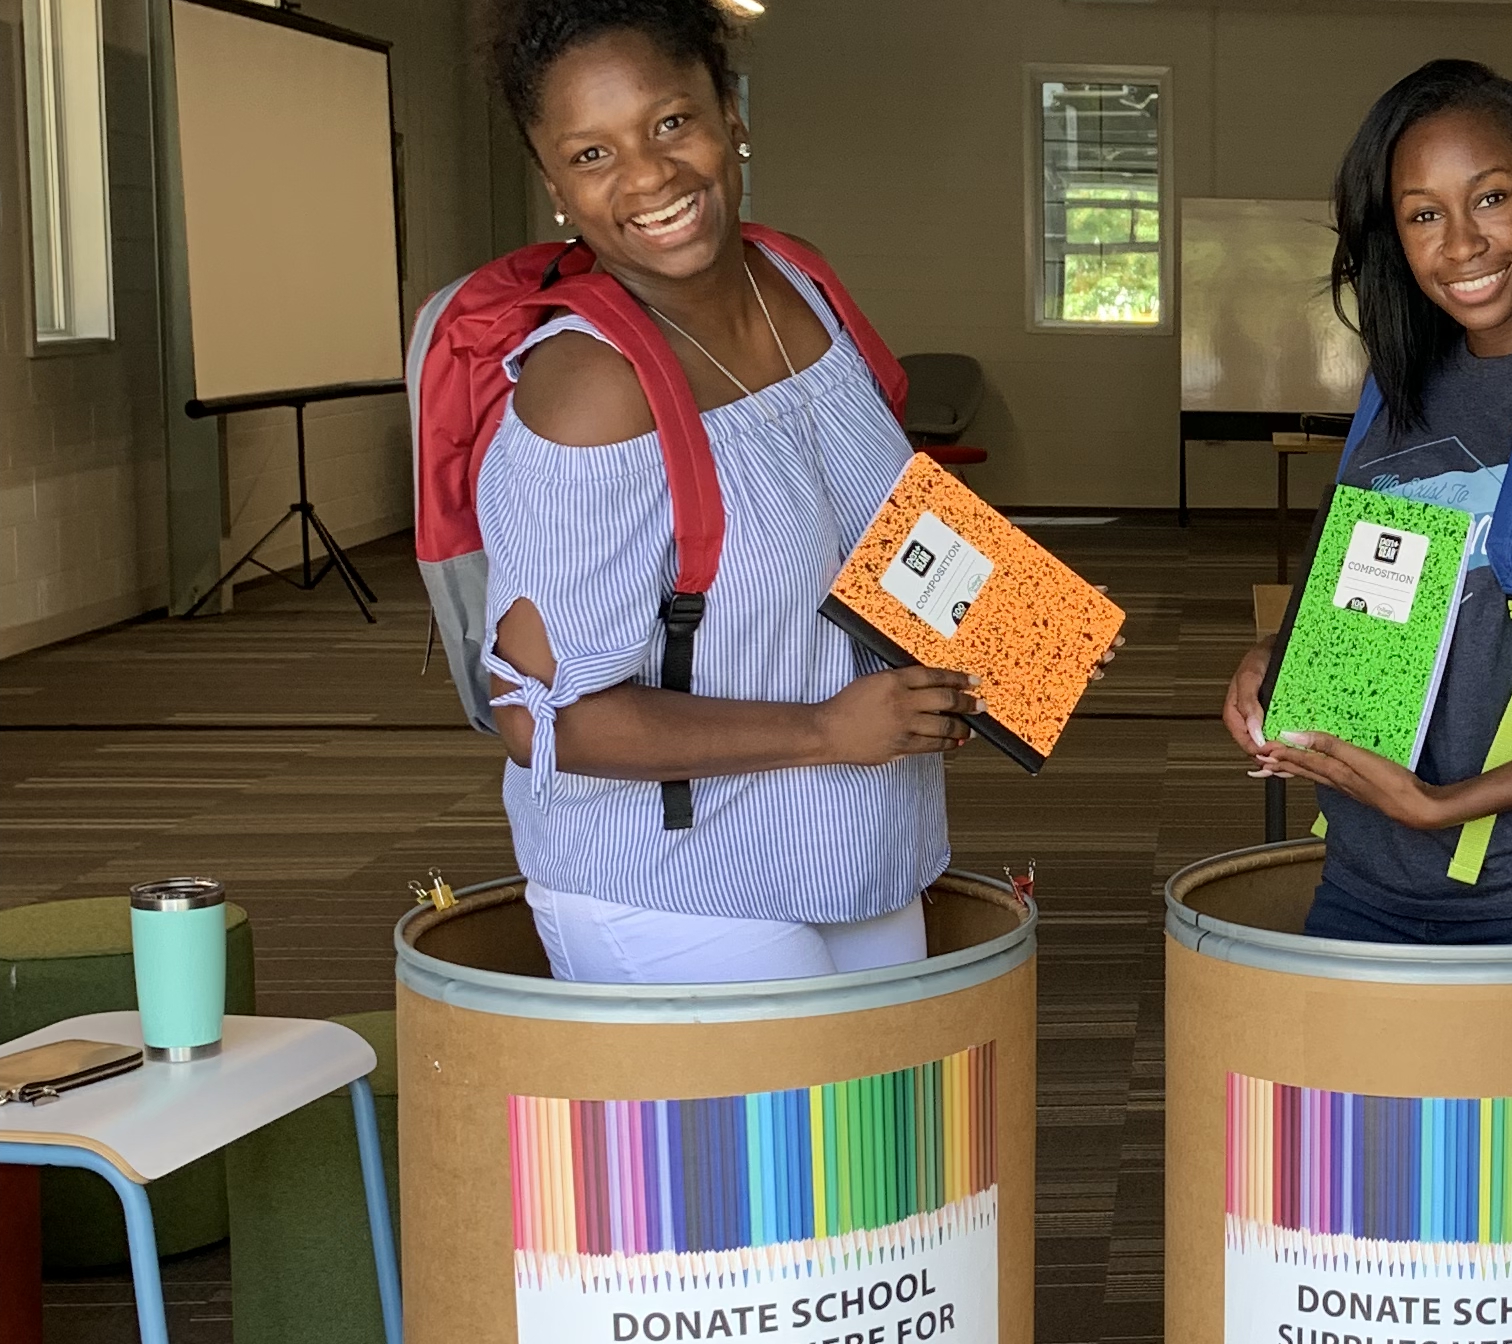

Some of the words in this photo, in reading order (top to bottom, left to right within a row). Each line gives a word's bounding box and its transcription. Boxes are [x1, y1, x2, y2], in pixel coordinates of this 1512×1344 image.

[1371, 474, 1400, 493] We
[1402, 477, 1448, 499] Exist
[1447, 483, 1470, 504] To
[915, 540, 962, 610] COMPOSITION
[1347, 561, 1415, 585] COMPOSITION
[952, 602, 966, 619] 100
[1350, 599, 1366, 609] 100
[613, 1303, 778, 1342] DONATE
[792, 1268, 936, 1328] SCHOOL
[1298, 1284, 1441, 1325] DONATE
